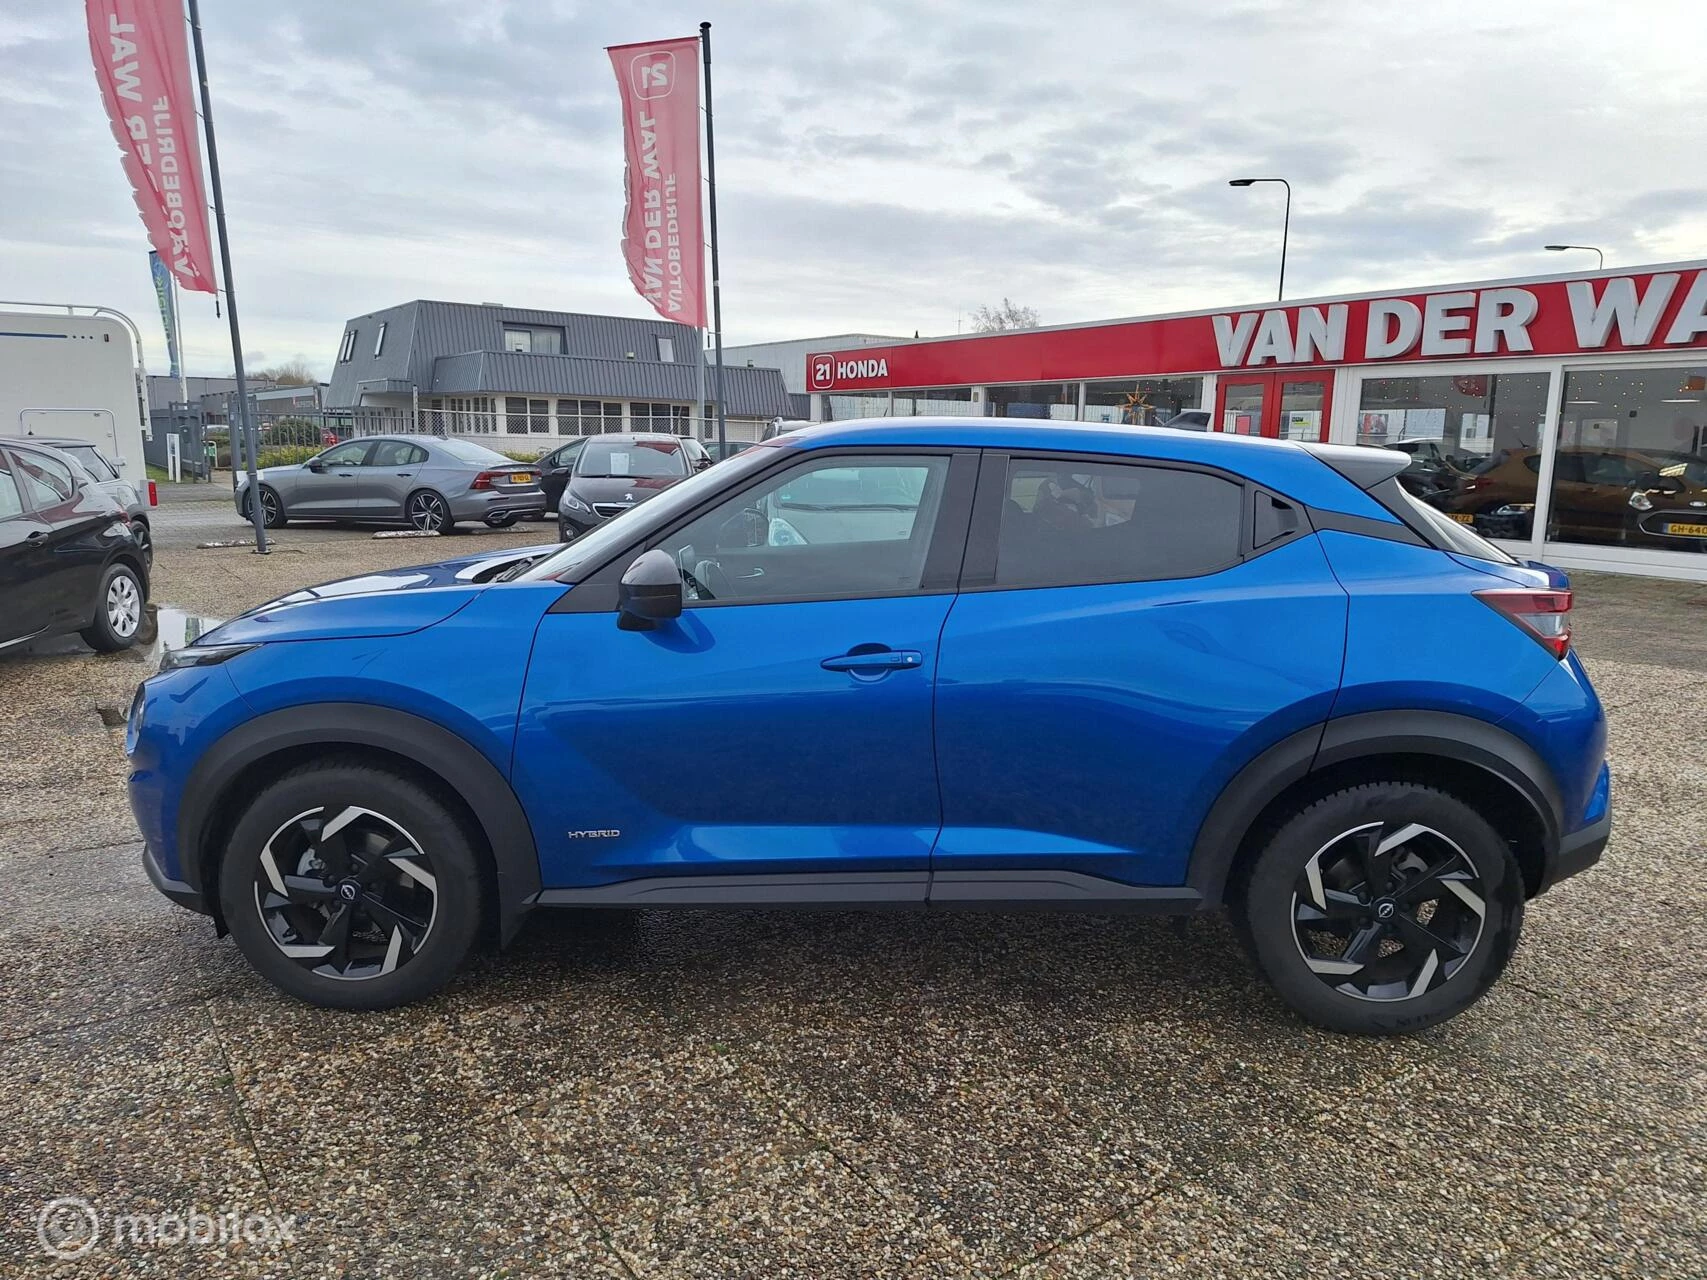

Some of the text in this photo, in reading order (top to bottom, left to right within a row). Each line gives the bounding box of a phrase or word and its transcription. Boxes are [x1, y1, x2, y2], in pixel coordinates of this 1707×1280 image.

[1211, 302, 1349, 367] VAN
[1364, 287, 1539, 359] DER
[815, 358, 888, 381] 21 HONDA
[567, 829, 621, 839] HYBRID
